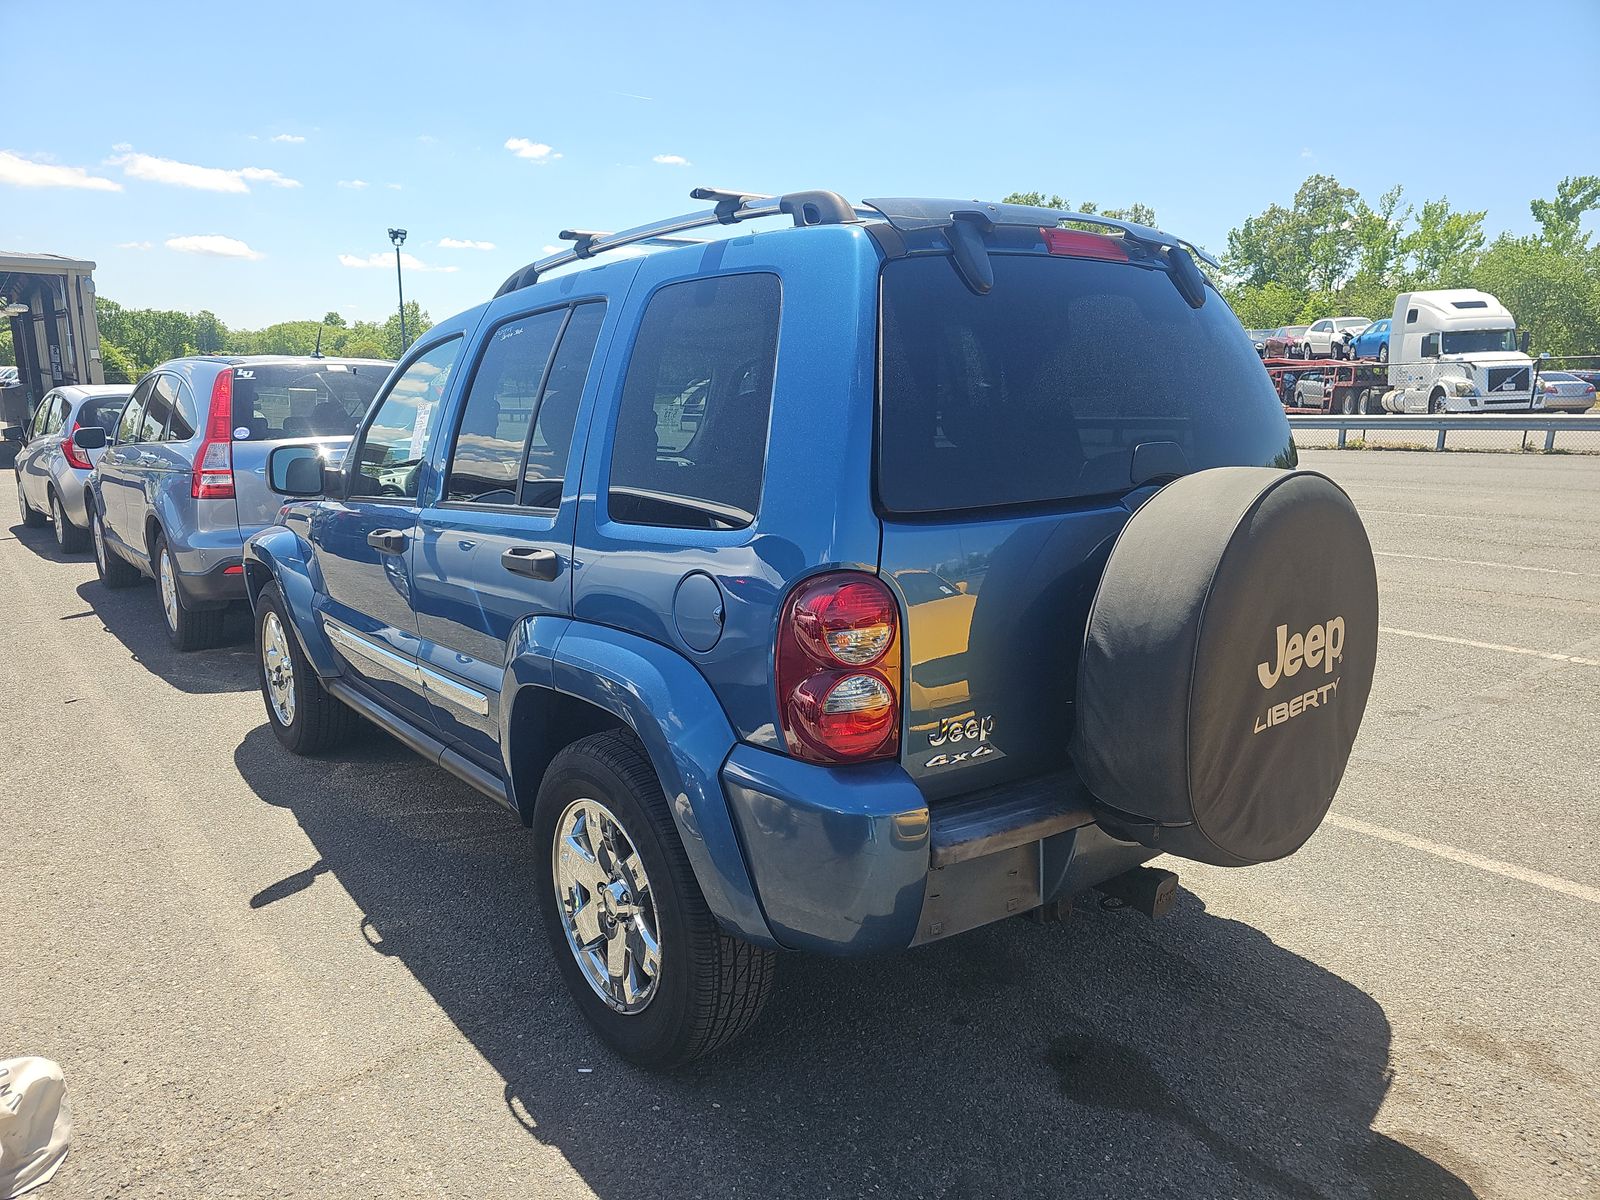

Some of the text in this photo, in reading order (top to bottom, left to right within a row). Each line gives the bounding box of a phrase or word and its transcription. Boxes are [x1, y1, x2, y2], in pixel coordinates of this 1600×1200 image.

[1257, 616, 1345, 689] Jeep
[928, 715, 994, 747] Jeep
[1253, 677, 1341, 734] LIBERTY
